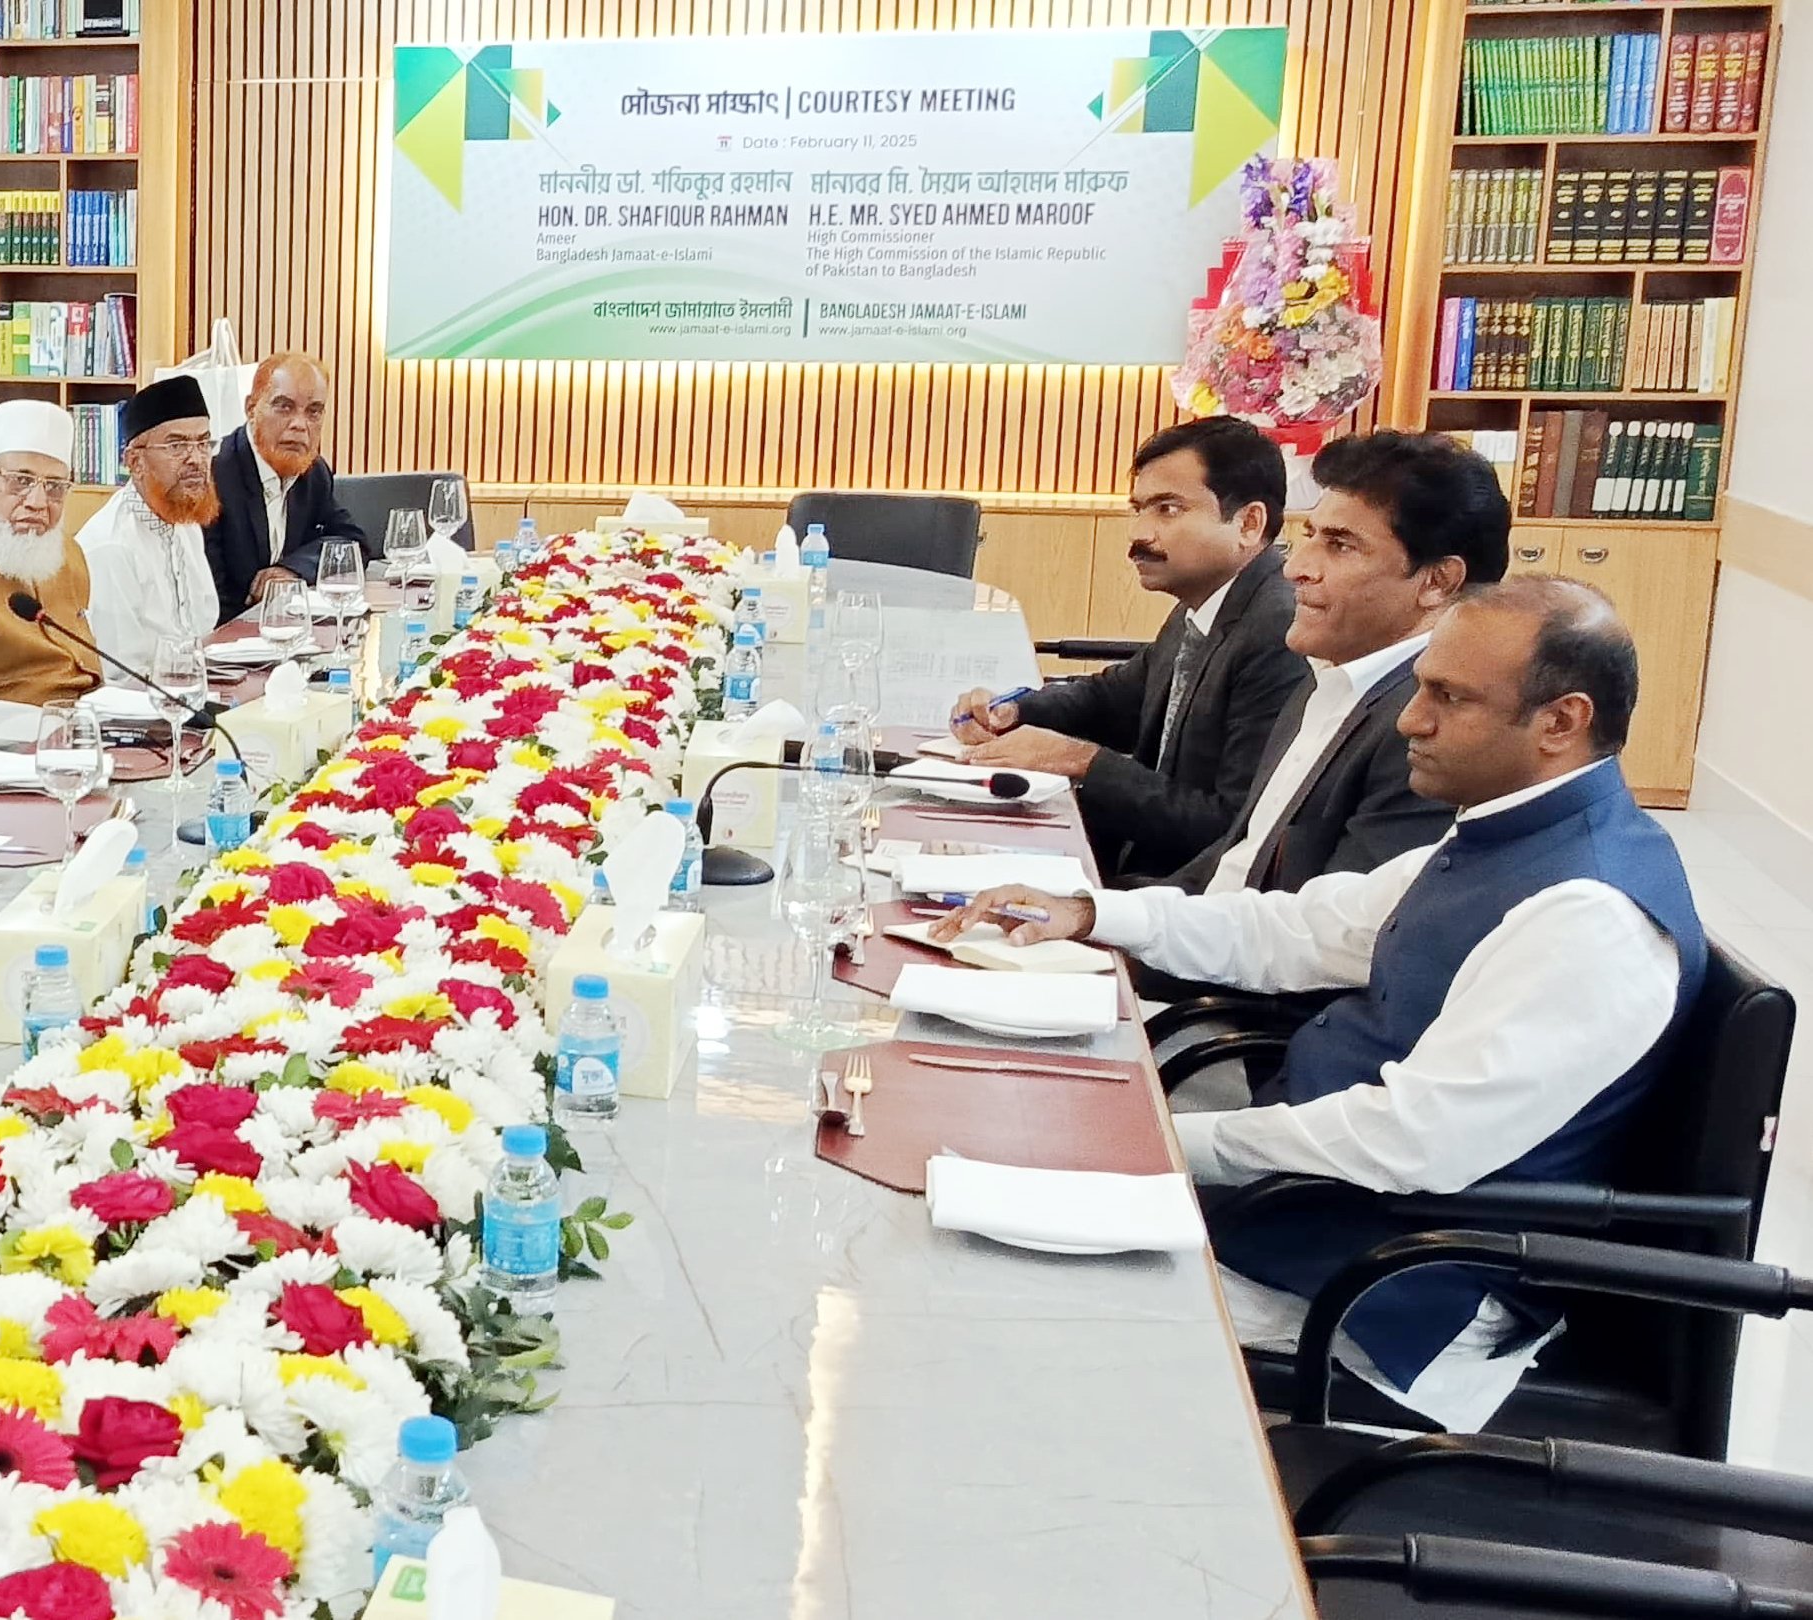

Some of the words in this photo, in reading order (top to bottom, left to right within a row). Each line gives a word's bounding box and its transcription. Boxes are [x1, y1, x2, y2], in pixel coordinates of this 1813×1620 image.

[620, 86, 701, 116] সৌজন্য
[705, 89, 779, 115] সাক্ষাৎ
[797, 88, 912, 114] COURTESY
[919, 87, 1016, 113] MEETING
[742, 136, 778, 150] Date
[790, 134, 857, 151] February
[861, 135, 875, 150] 11,
[880, 134, 918, 148] 2025
[538, 163, 613, 195] মাননীয়
[616, 169, 645, 194] ডা.
[650, 165, 726, 201] শফিকুর
[729, 169, 794, 195] রহমান
[810, 169, 883, 196] মান্যবর
[886, 165, 913, 194] মি.
[918, 164, 973, 195] সৈয়দ
[977, 168, 1059, 194] আহমেদ
[1063, 168, 1130, 195] মারুফ
[538, 204, 579, 228] HON.
[585, 204, 612, 228] DR.
[618, 204, 705, 228] SHAFIQUR
[710, 203, 789, 227] RAHMAN
[808, 203, 843, 226] H.E.
[849, 203, 883, 226] MR.
[889, 203, 937, 226] SYED
[942, 203, 1010, 226] AHMED
[1015, 202, 1096, 225] MAROOF
[536, 232, 577, 246] Ameer
[807, 230, 837, 245] High
[841, 229, 934, 244] Commissioner
[536, 247, 608, 264] Bangladesh
[611, 246, 713, 262] Jamaat-e-Islami
[806, 247, 830, 261] The
[834, 247, 863, 263] High
[867, 246, 948, 261] Commission
[951, 246, 966, 261] of
[969, 246, 992, 261] the
[995, 246, 1043, 261] Islamic
[1047, 246, 1107, 263] Republic
[805, 263, 819, 278] of
[822, 263, 878, 278] Pakistan
[882, 264, 896, 278] to
[899, 263, 977, 280] Bangladesh
[592, 299, 661, 319] বাংলাদেশ
[664, 299, 736, 320] জামায়াতে
[739, 296, 793, 319] ইসলামী
[819, 303, 906, 320] BANGLADESH
[909, 303, 1027, 320] JAMAAT-E-ISLAMI
[649, 324, 792, 338] www.jamaat-e-islami.org
[818, 325, 967, 338] www.jamaat-e-islami.org
